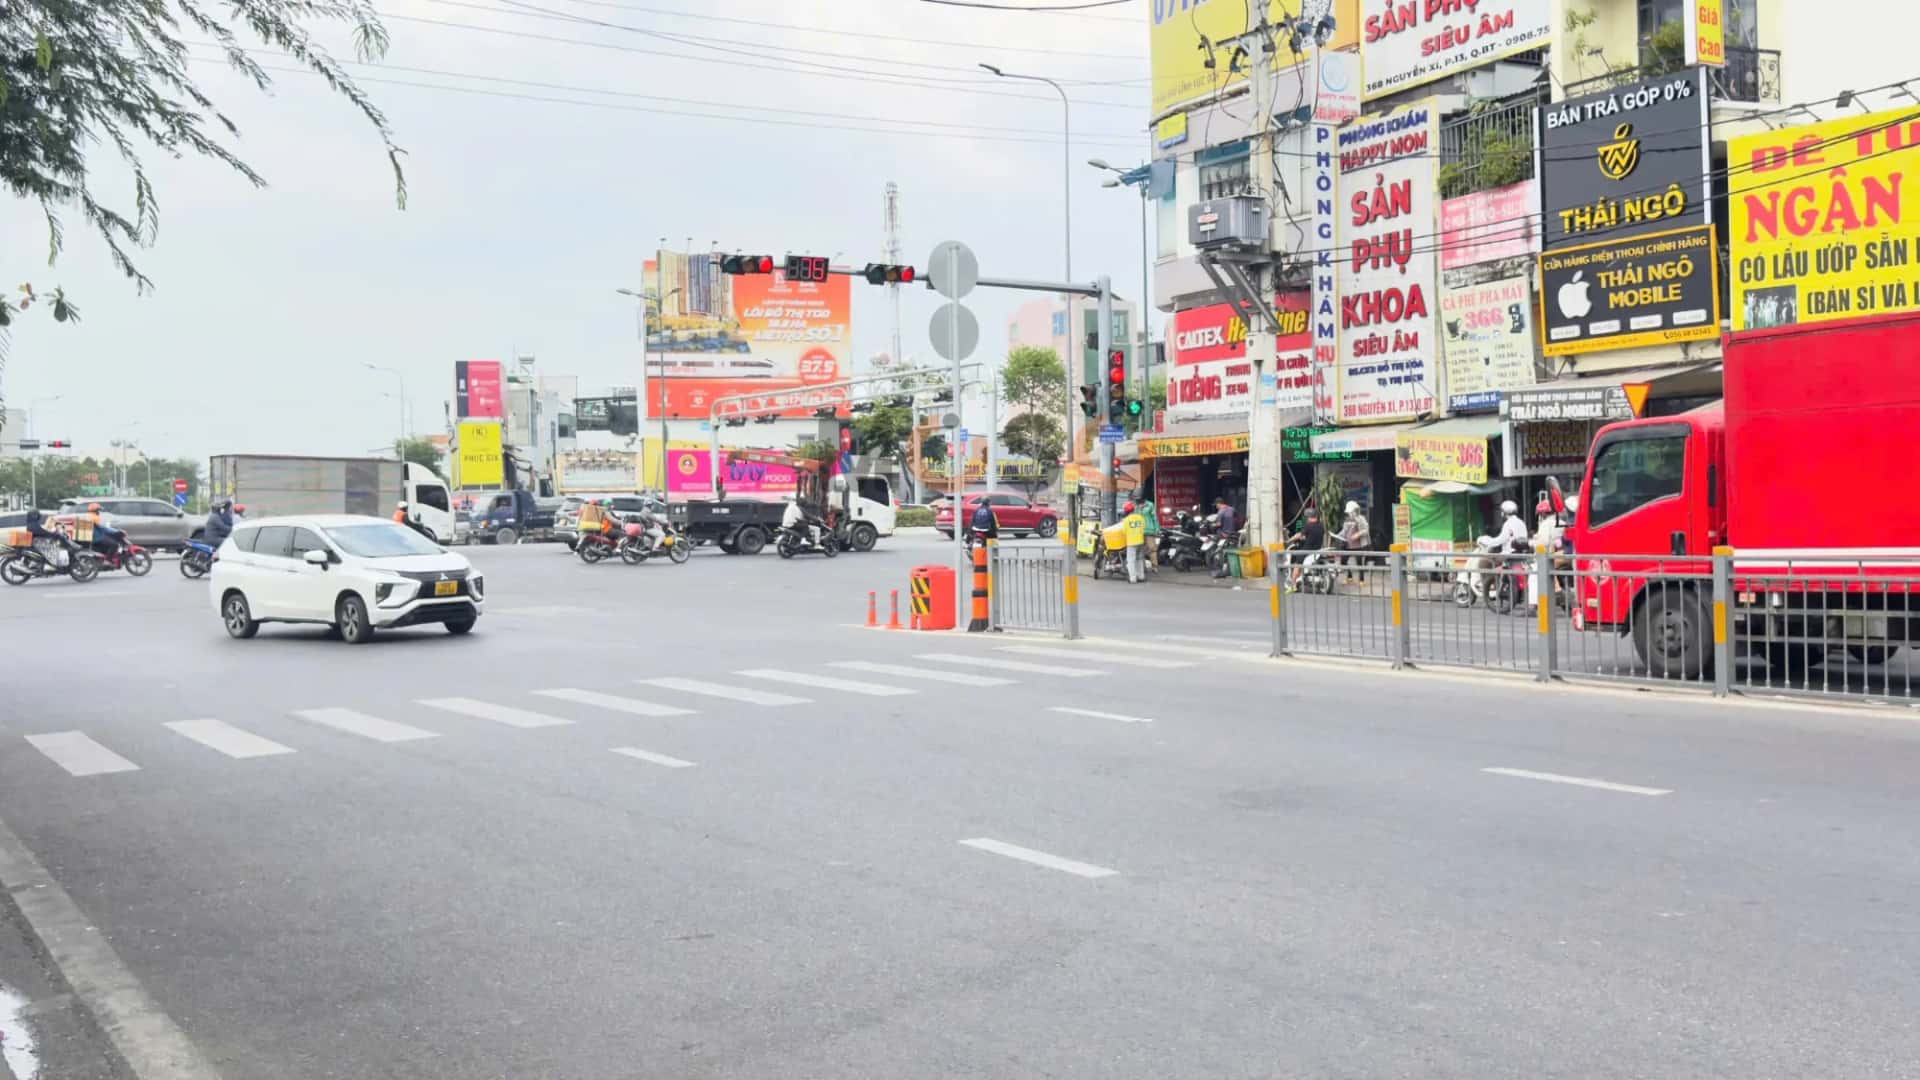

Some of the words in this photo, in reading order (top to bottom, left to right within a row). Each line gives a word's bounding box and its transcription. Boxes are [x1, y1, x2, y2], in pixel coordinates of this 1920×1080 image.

[1421, 25, 1470, 57] SIÊU
[1475, 8, 1514, 39] ÂM
[1699, 6, 1719, 25] Giá
[1699, 36, 1721, 57] Cao
[1386, 64, 1426, 85] NGUYỄN
[1546, 104, 1581, 128] BÁN
[1584, 93, 1619, 120] TRẢ
[1623, 86, 1660, 110] GÓP
[1664, 79, 1691, 101] 0%
[1338, 124, 1385, 146] PHÒNG
[1386, 110, 1428, 134] KHÁM
[1340, 141, 1388, 170] HAPPY
[1390, 131, 1428, 155] MOM
[1752, 135, 1825, 173] DÊ
[1350, 173, 1412, 226] SẢN
[1559, 197, 1617, 234] THÁI
[1625, 184, 1686, 222] NGÔ
[1744, 166, 1903, 243] NGÂN
[1351, 228, 1413, 275] PHỤ
[1544, 258, 1562, 271] CỬA
[1564, 255, 1590, 268] HÀNG
[1591, 249, 1614, 263] ĐIỆN
[1616, 246, 1644, 258] THOẠI
[1646, 240, 1677, 253] CHÍNH
[1678, 235, 1708, 249] HÃNG
[1739, 253, 1766, 283] CÓ
[1773, 243, 1808, 279] LẨU
[1816, 241, 1858, 275] ƯỚP
[1865, 232, 1908, 270] SẴN
[1597, 262, 1643, 288] THÁI
[1648, 254, 1694, 281] NGÔ
[1341, 284, 1428, 330] KHOA
[1608, 283, 1683, 309] MOBILE
[1857, 280, 1876, 310] SỈ
[1882, 279, 1907, 308] VÀ
[1464, 308, 1505, 330] 366
[1177, 325, 1225, 350] CALTEX
[1353, 333, 1389, 358] SIÊU
[1392, 329, 1419, 352] ÂM
[1452, 394, 1468, 407] 366
[1511, 404, 1537, 419] THÁI
[1538, 402, 1561, 418] NGÔ
[1562, 403, 1603, 418] MOBILE
[1175, 441, 1190, 454] XE
[1193, 438, 1232, 453] HONDA
